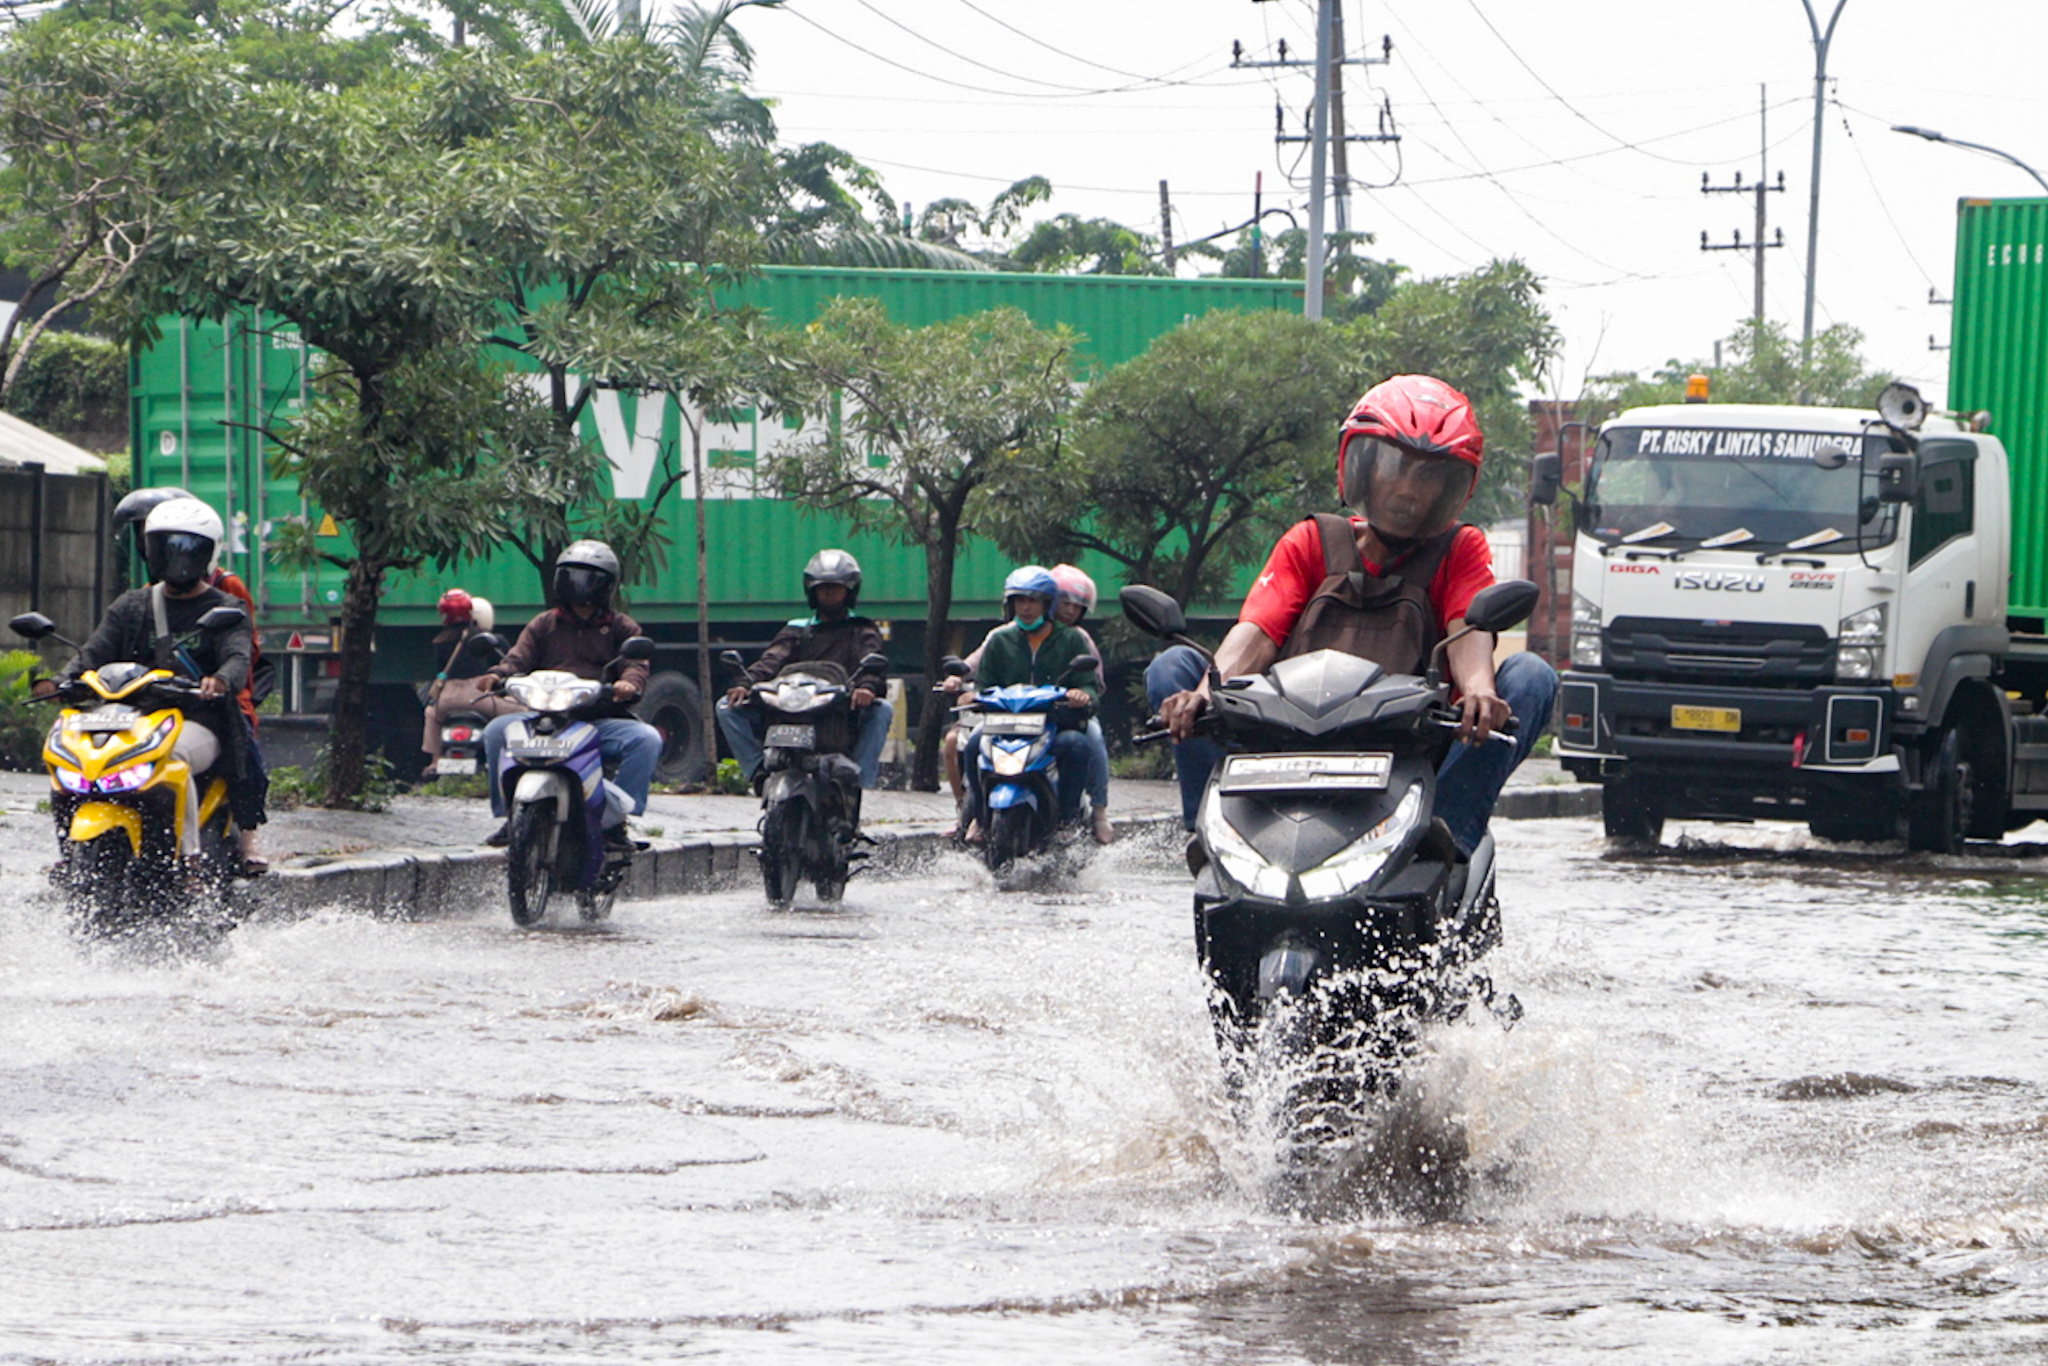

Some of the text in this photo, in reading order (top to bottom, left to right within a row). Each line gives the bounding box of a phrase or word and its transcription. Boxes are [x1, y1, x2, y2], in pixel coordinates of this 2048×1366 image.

[1638, 429, 1661, 454] PT.
[1663, 430, 1713, 456] RISKY
[1713, 432, 1773, 457] LINTAS
[1609, 564, 1660, 575] GIGA
[1789, 572, 1836, 582] GVR
[1674, 570, 1766, 593] ISUZU
